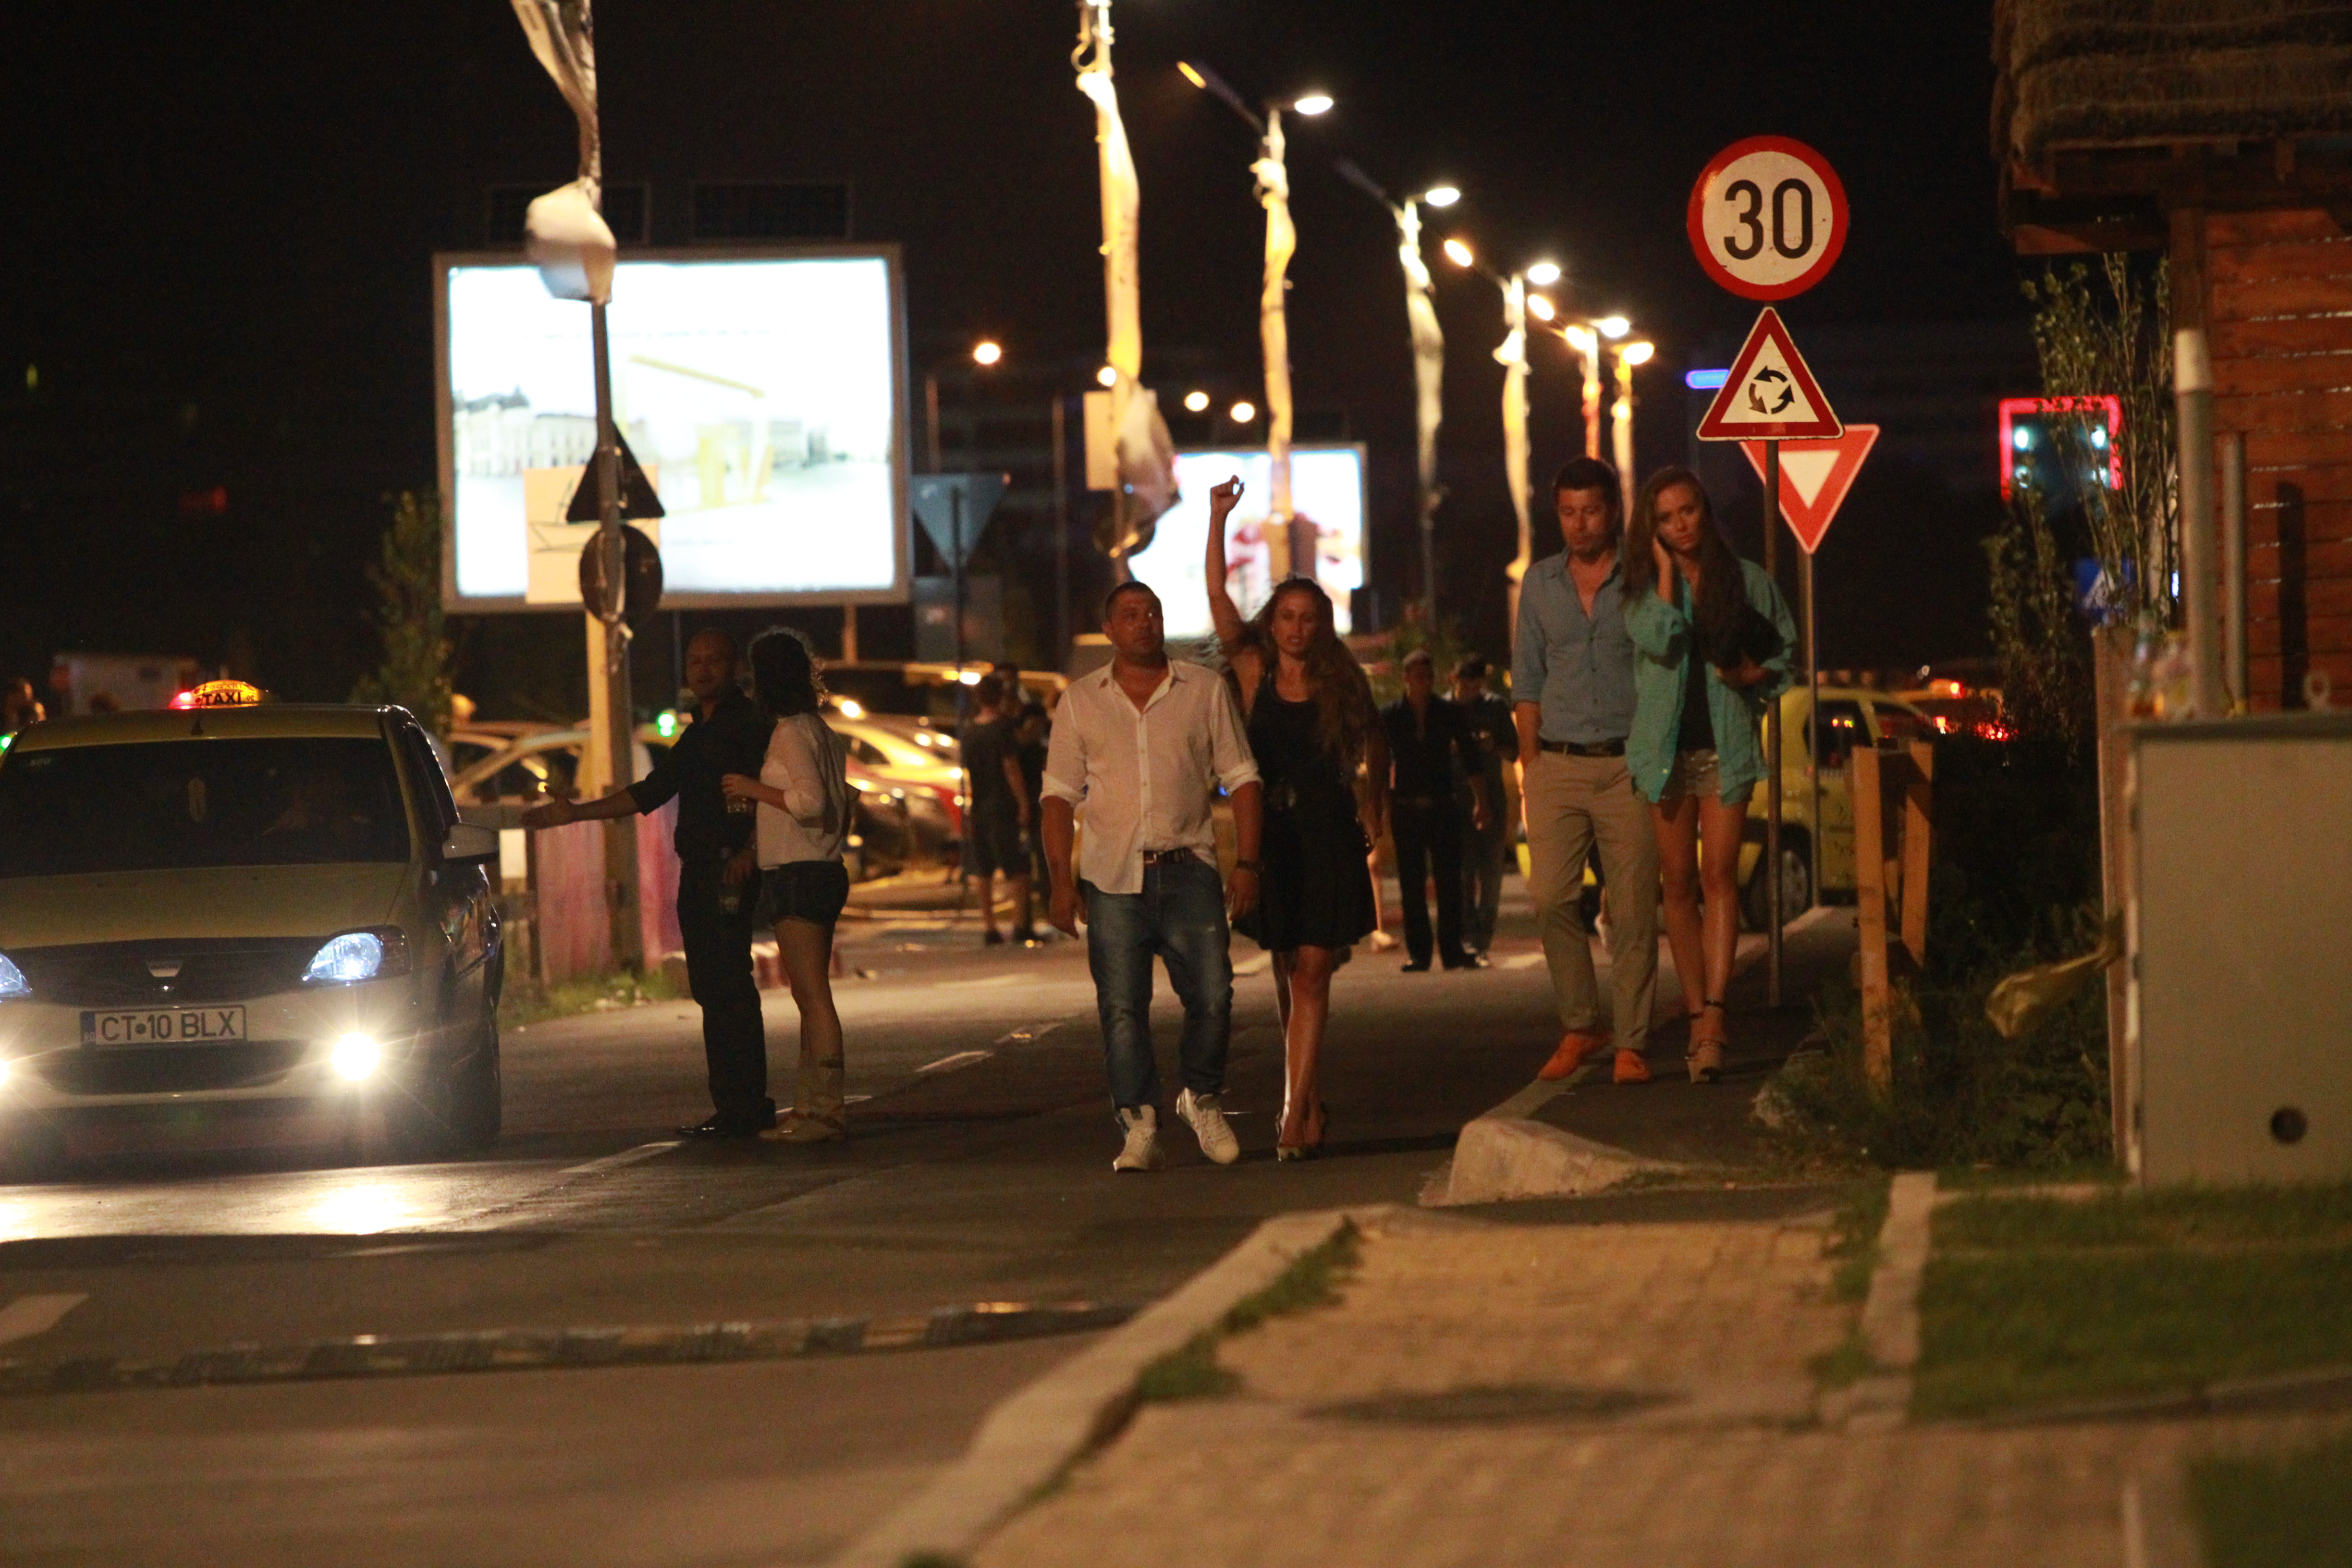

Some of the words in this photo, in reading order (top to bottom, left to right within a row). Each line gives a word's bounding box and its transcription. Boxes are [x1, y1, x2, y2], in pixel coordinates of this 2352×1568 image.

[1724, 178, 1813, 260] 30
[203, 692, 241, 705] TAXI
[181, 1011, 235, 1038] BLX
